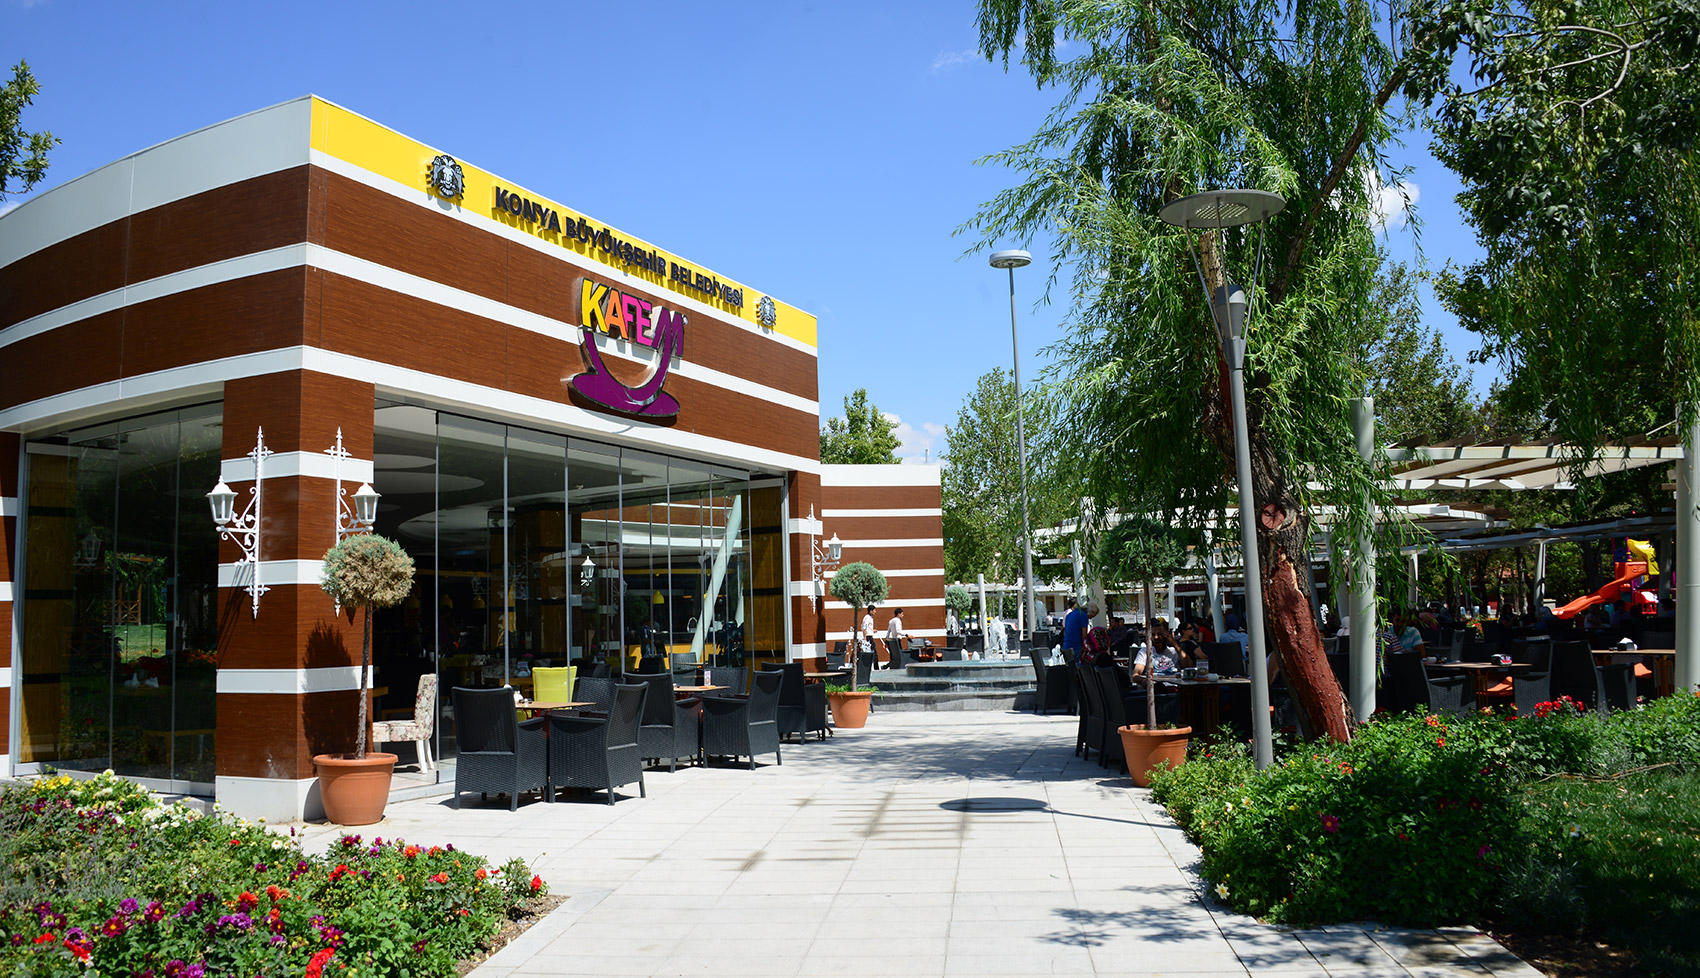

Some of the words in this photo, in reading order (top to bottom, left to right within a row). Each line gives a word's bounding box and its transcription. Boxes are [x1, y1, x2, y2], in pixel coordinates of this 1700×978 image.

[495, 186, 562, 233] KONYA
[565, 216, 666, 277] BÜYÜKŞEHİR
[670, 262, 743, 308] BELEDİYESİ
[581, 277, 685, 358] KAFEM
